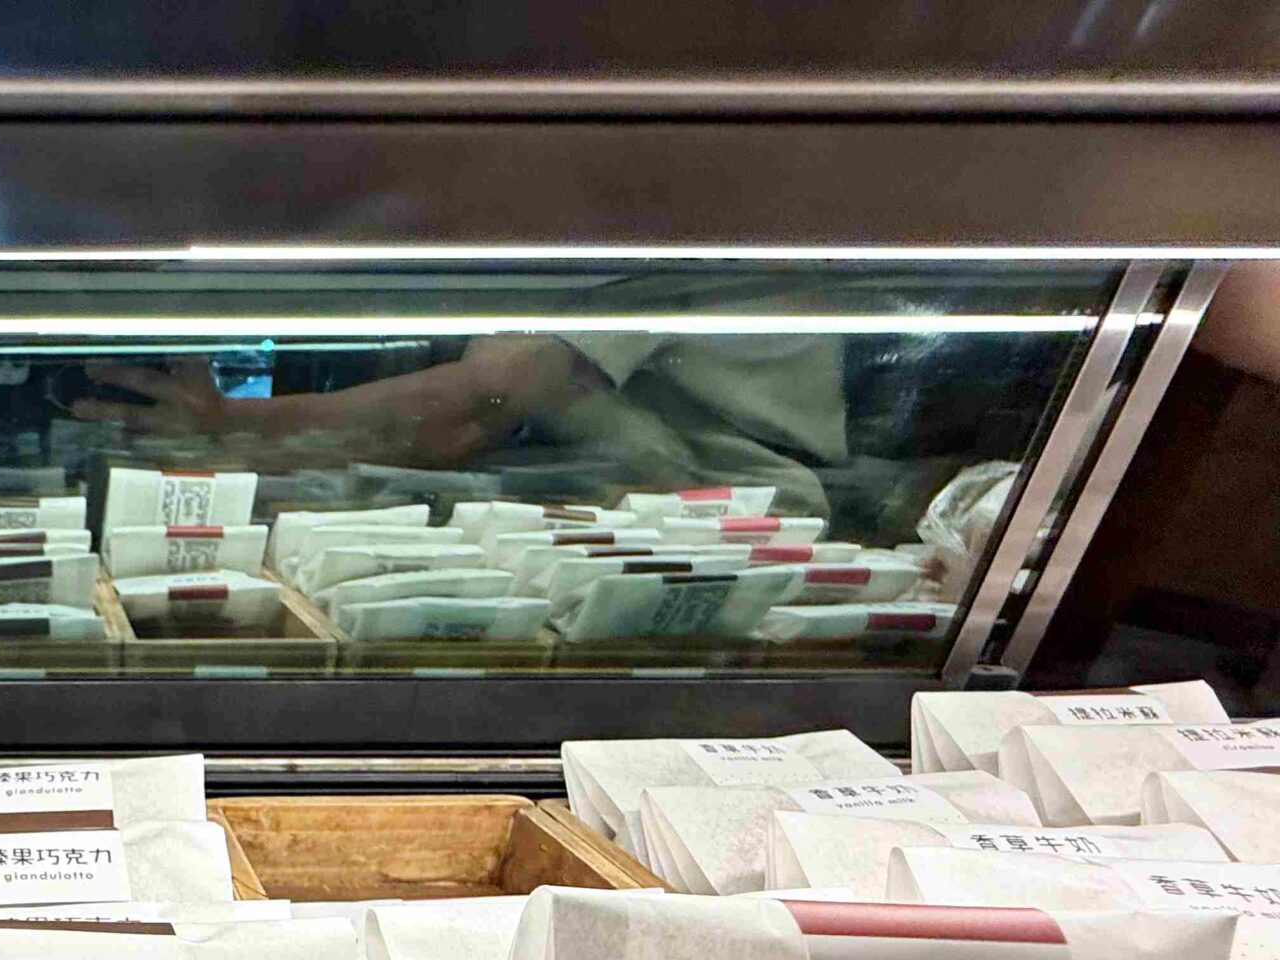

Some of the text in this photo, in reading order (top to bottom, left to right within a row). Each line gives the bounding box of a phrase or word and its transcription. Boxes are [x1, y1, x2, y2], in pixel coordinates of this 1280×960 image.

[5, 787, 83, 798] gianduiotto
[808, 782, 919, 800] 香草牛奶
[835, 799, 884, 810] vanilla
[969, 833, 1103, 854] 香草牛奶
[4, 871, 94, 883] gianduiotto
